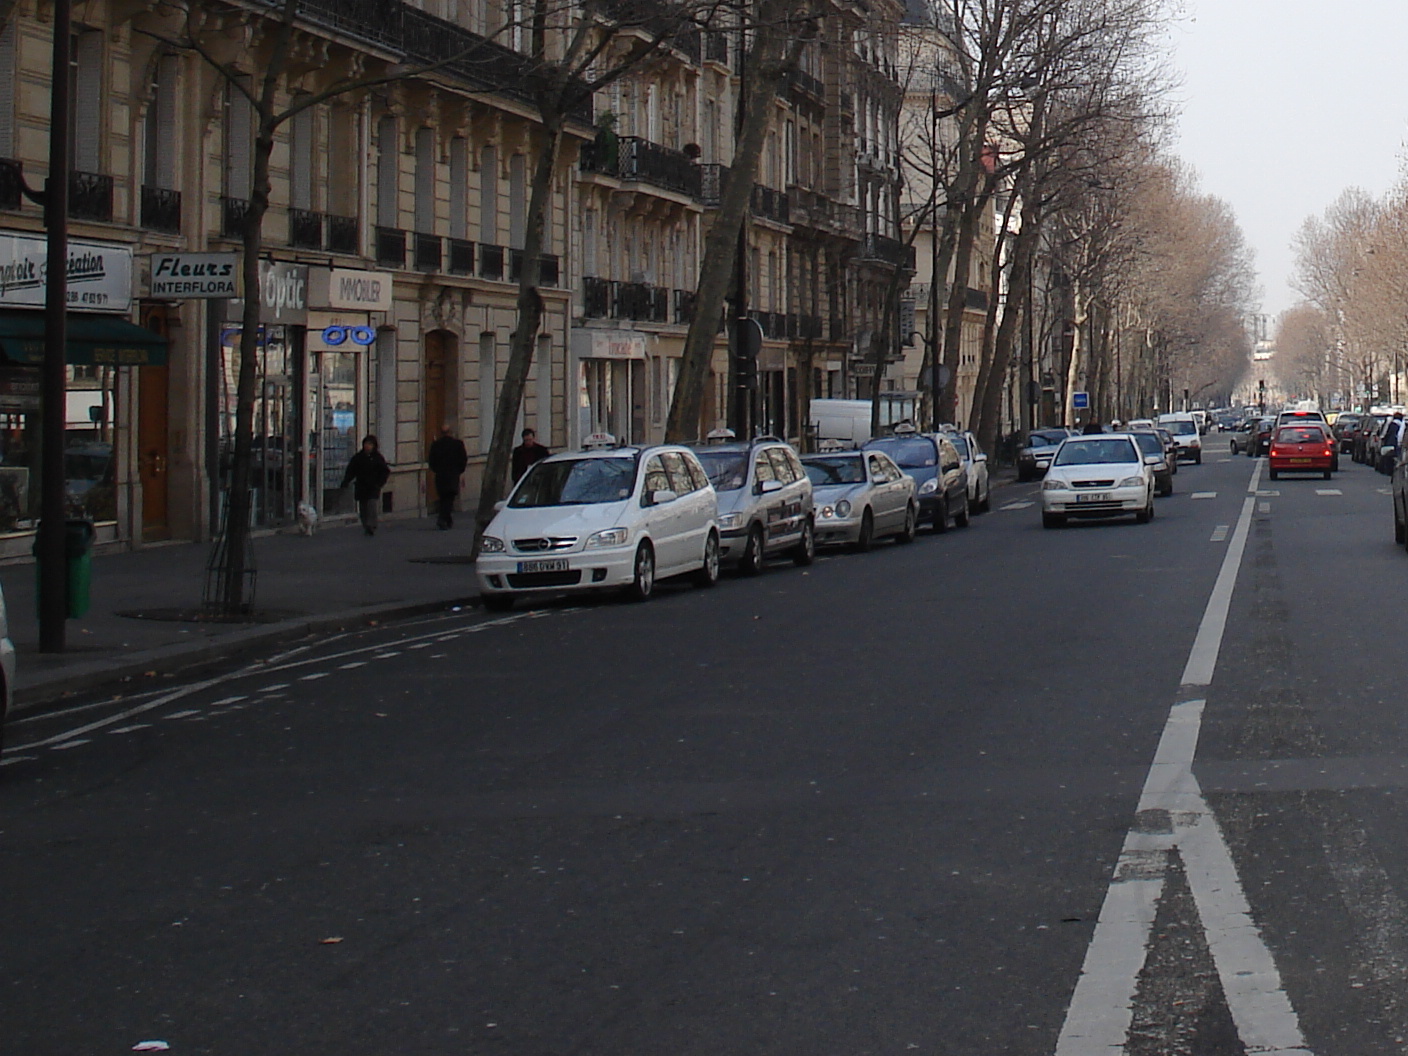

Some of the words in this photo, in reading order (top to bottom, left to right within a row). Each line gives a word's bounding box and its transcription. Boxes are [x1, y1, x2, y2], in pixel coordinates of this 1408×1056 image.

[156, 258, 232, 276] Fleurs
[153, 282, 234, 292] INTERFLORA
[266, 269, 304, 318] Optic
